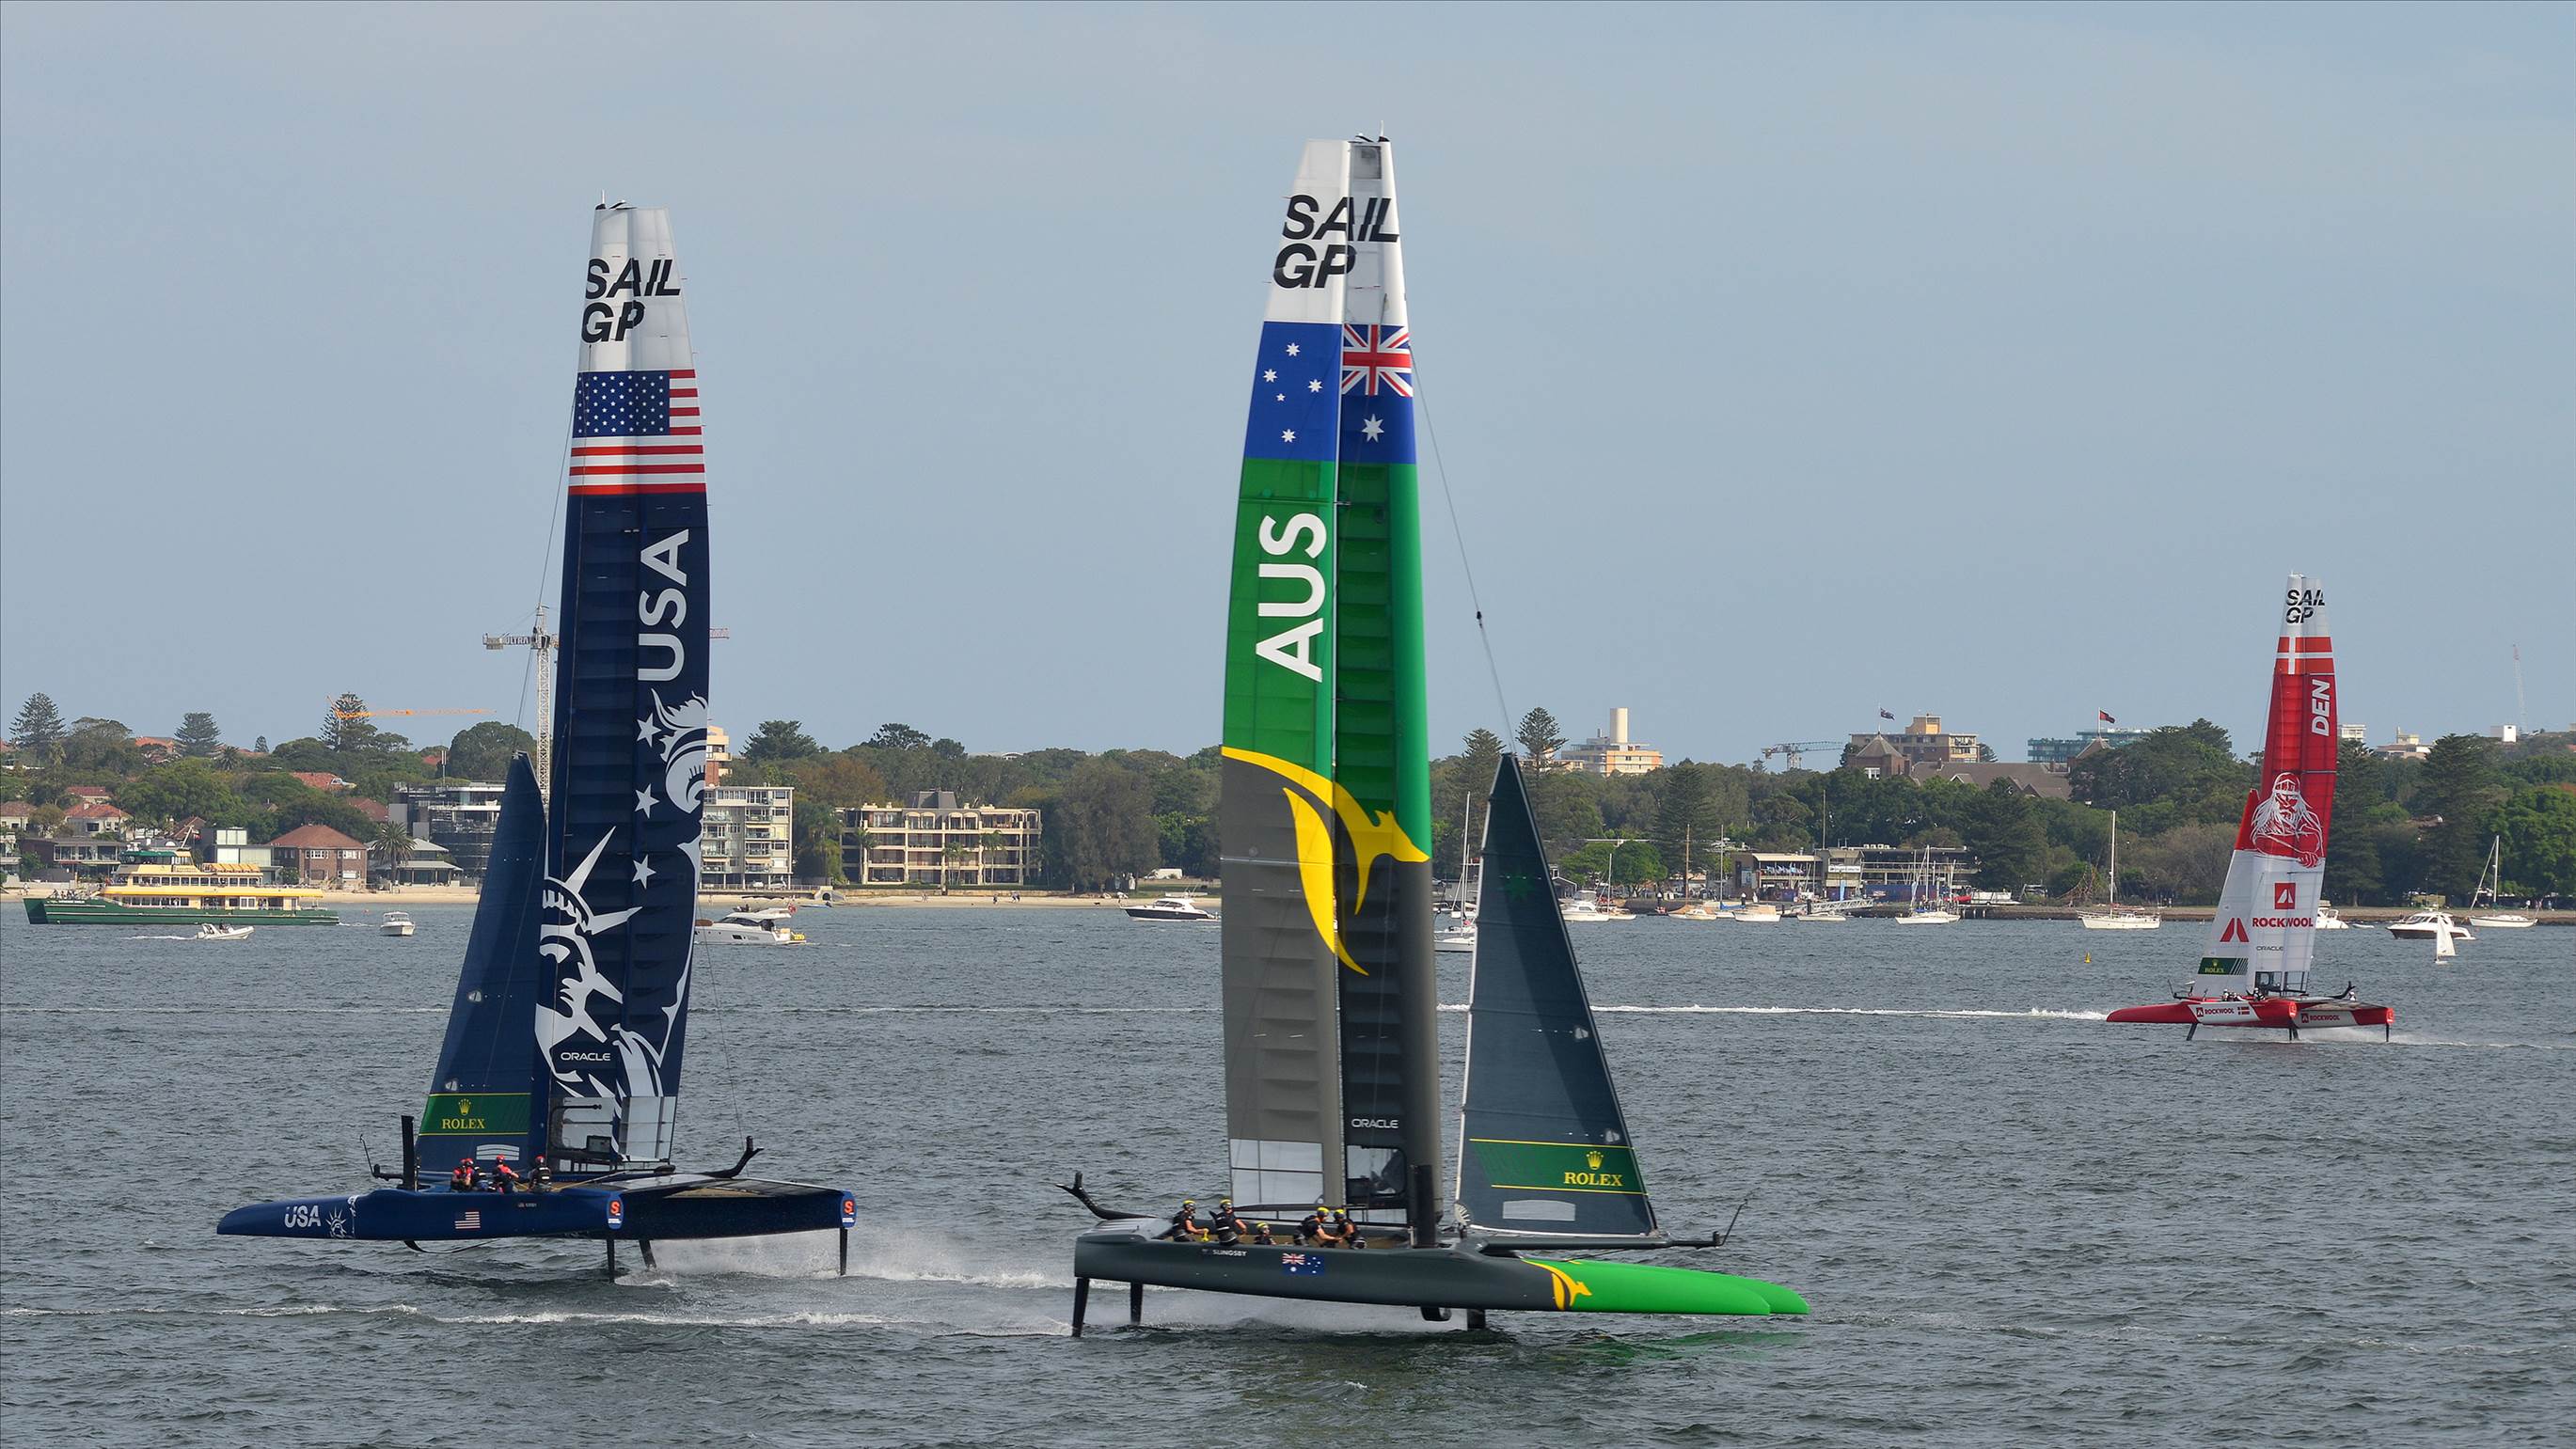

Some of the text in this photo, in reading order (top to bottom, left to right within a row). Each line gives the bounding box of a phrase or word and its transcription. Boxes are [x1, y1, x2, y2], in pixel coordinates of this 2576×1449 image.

[1282, 195, 1399, 243] SAIL
[1272, 243, 1356, 289] GP
[585, 258, 681, 299] SAIL
[581, 300, 645, 343] GP
[638, 528, 689, 681] USA
[1256, 513, 1327, 683] AUS
[2286, 589, 2326, 606] SAIL
[2285, 606, 2314, 624] GP
[2311, 679, 2331, 737] DEN
[2252, 917, 2314, 928] ROCKWOOL
[561, 1052, 611, 1062] ORACLE
[441, 1118, 485, 1129] ROLEX
[1351, 1118, 1399, 1129] ORACLE
[1563, 1172, 1624, 1187] ROLEX
[284, 1205, 322, 1228] USA
